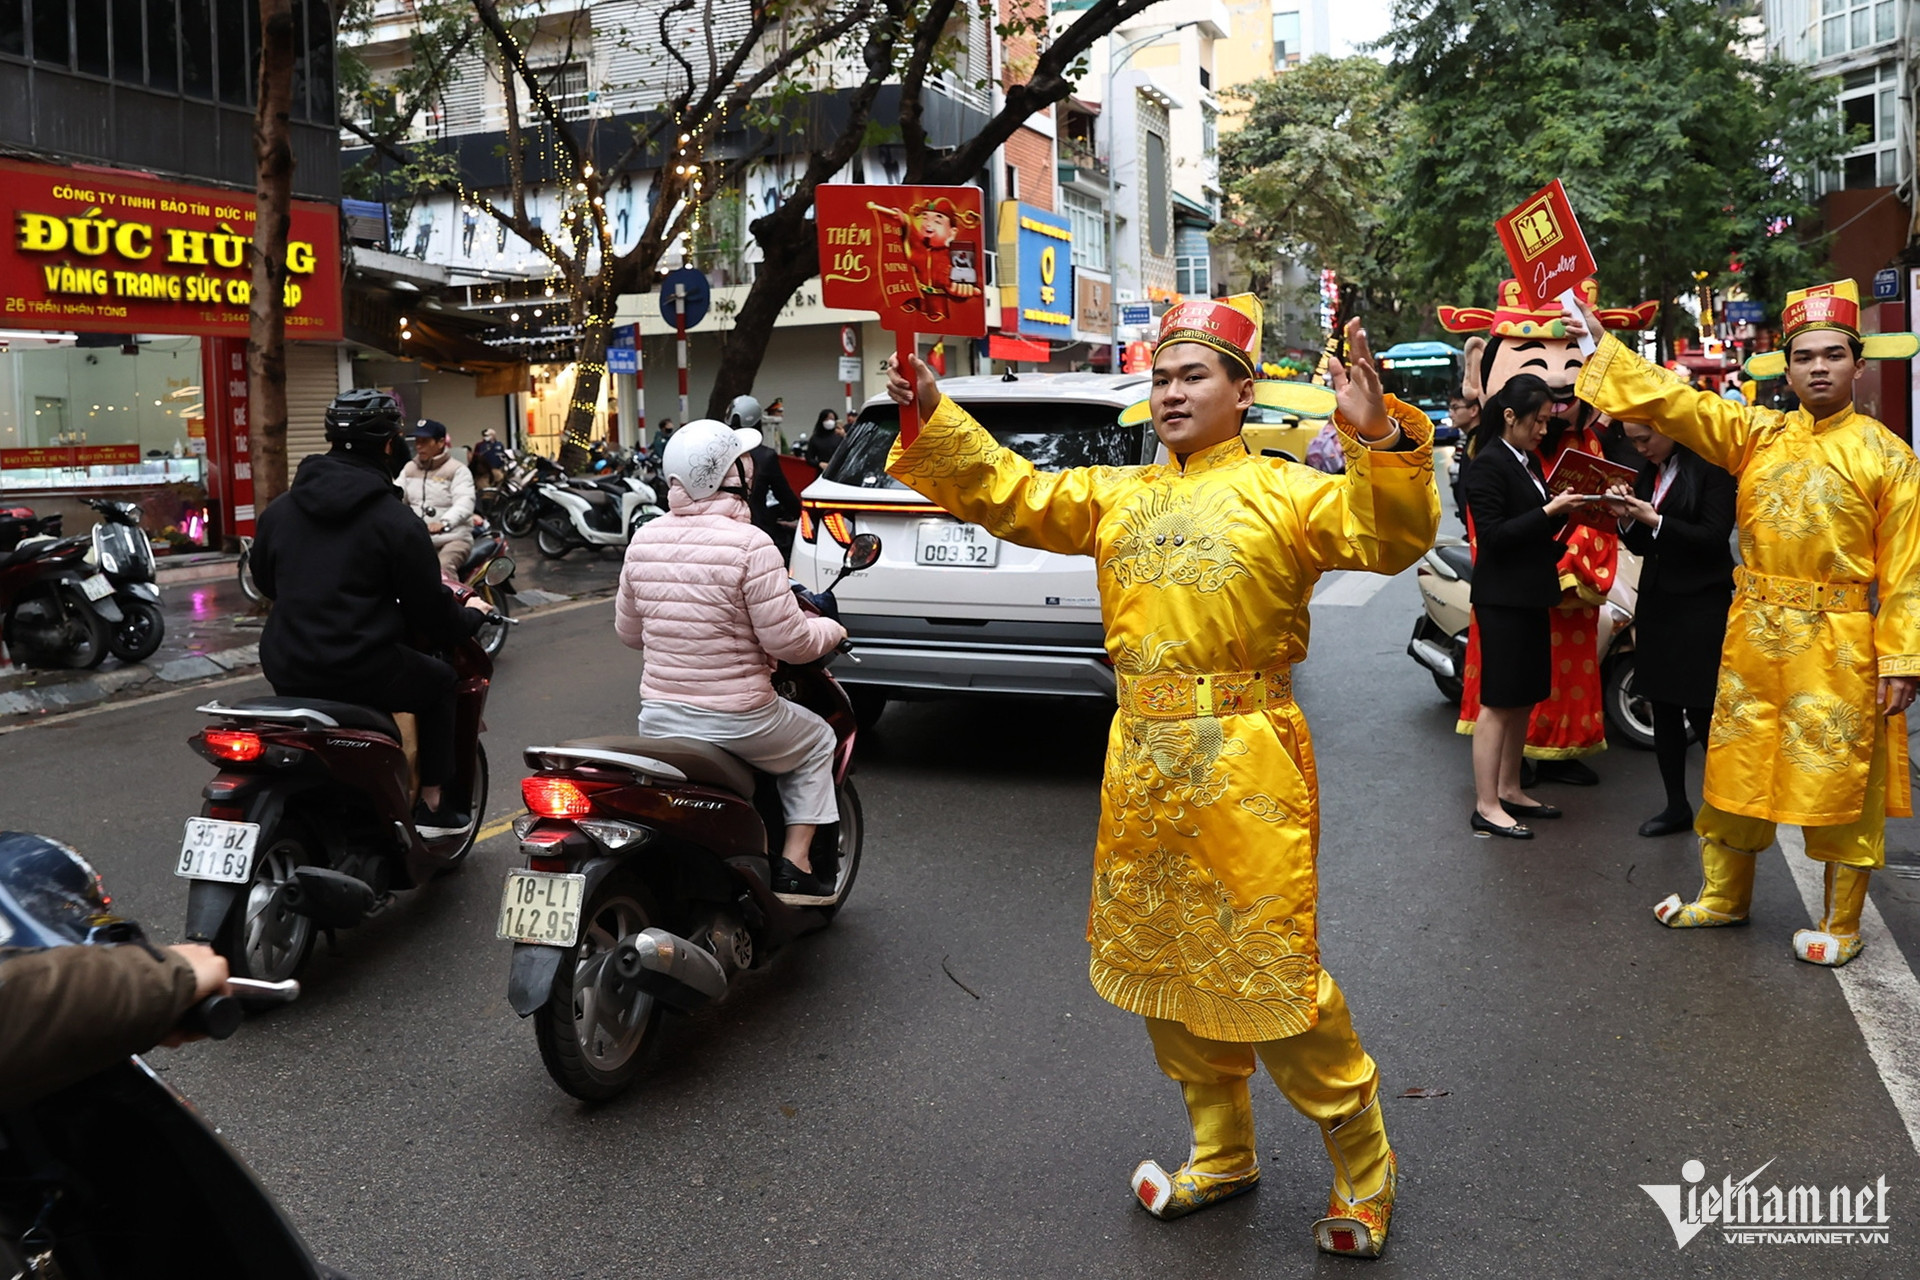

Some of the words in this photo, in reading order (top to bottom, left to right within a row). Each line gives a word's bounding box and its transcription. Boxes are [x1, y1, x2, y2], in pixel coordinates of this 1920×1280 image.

[53, 184, 95, 202] CÔNG
[98, 192, 116, 205] TY
[120, 195, 156, 210] TNHH
[160, 197, 187, 214] BẢO
[190, 203, 210, 216] TÍN
[215, 205, 241, 220] ĐỨC
[19, 206, 153, 260] ĐỨC
[166, 222, 317, 274] HÙG
[826, 223, 872, 246] THÊM
[830, 248, 872, 278] LỘC
[1534, 255, 1577, 299] Jewelry
[44, 261, 108, 295] VÀNG
[113, 271, 181, 301] TRANG
[186, 272, 222, 303] SÚC
[227, 279, 252, 305] CA
[1880, 284, 1892, 295] 17
[5, 298, 26, 312] 26
[941, 526, 975, 544] 30M
[193, 824, 247, 851] 35-B2
[181, 849, 247, 878] 911.69
[516, 877, 570, 908] 18-L1
[505, 907, 575, 942] 142.95
